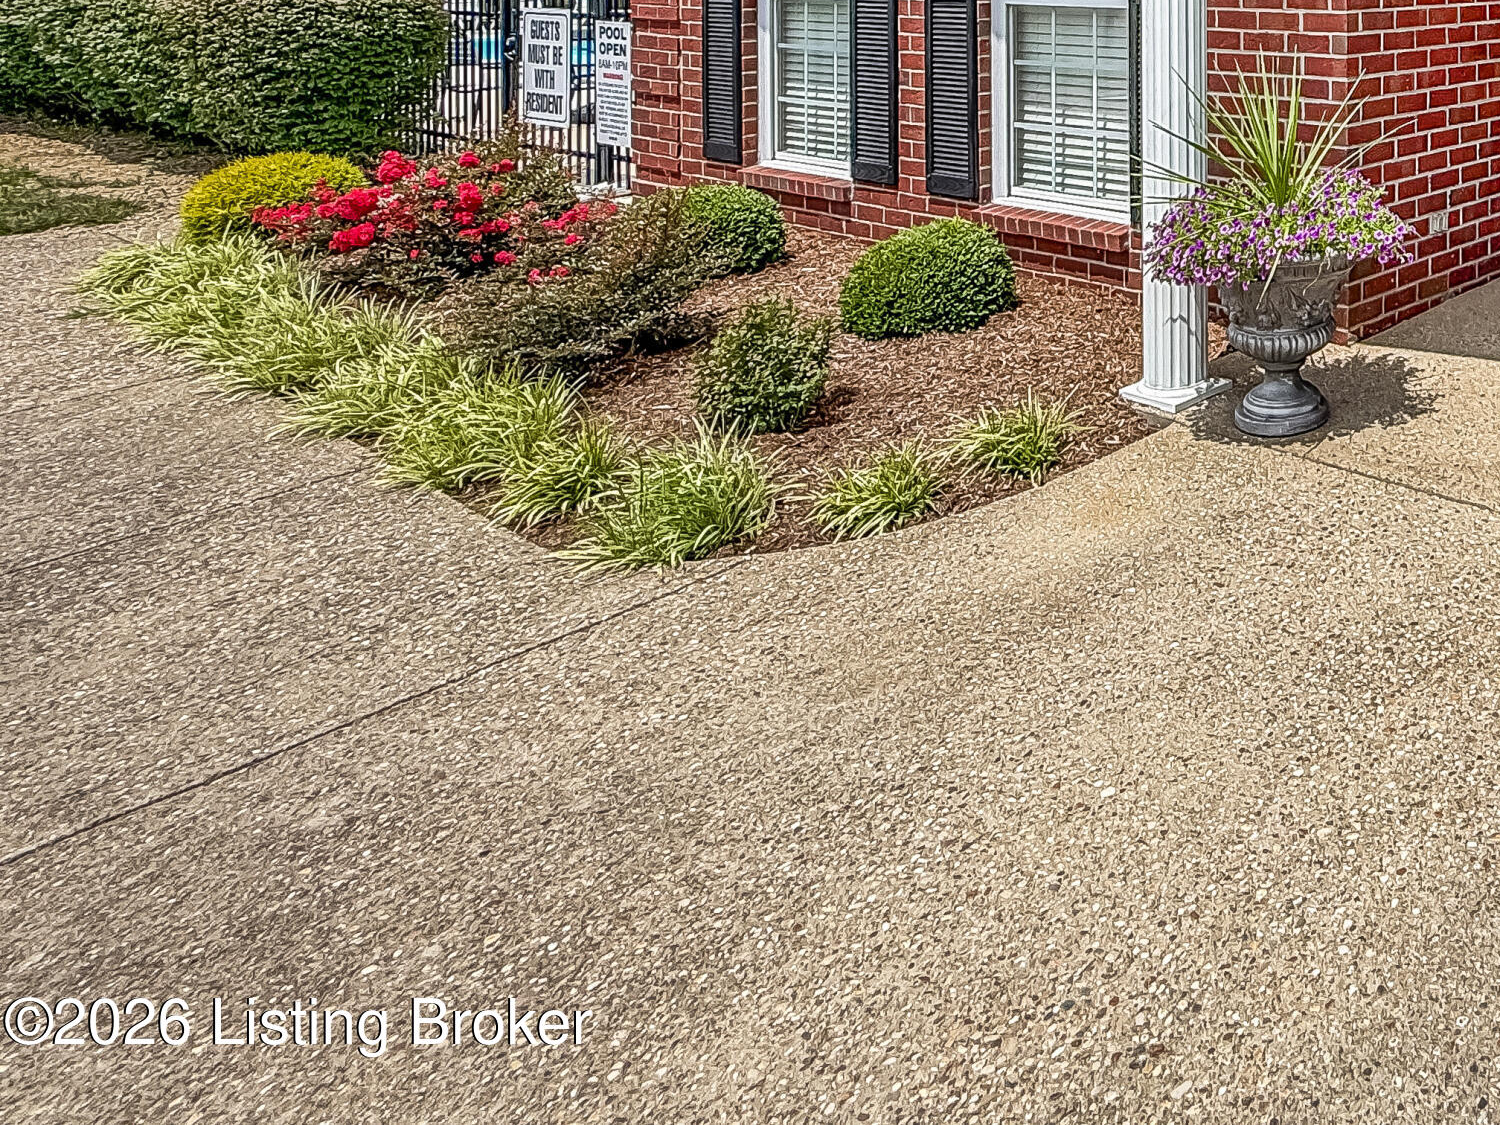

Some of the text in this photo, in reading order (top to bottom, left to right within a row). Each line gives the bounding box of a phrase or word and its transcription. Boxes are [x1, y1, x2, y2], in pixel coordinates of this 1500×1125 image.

[530, 19, 560, 41] GUESTS
[599, 25, 627, 40] POOL
[528, 43, 563, 66] MUST BE
[599, 42, 627, 57] OPEN
[534, 68, 555, 90] WITH
[526, 91, 563, 115] RESIDENT
